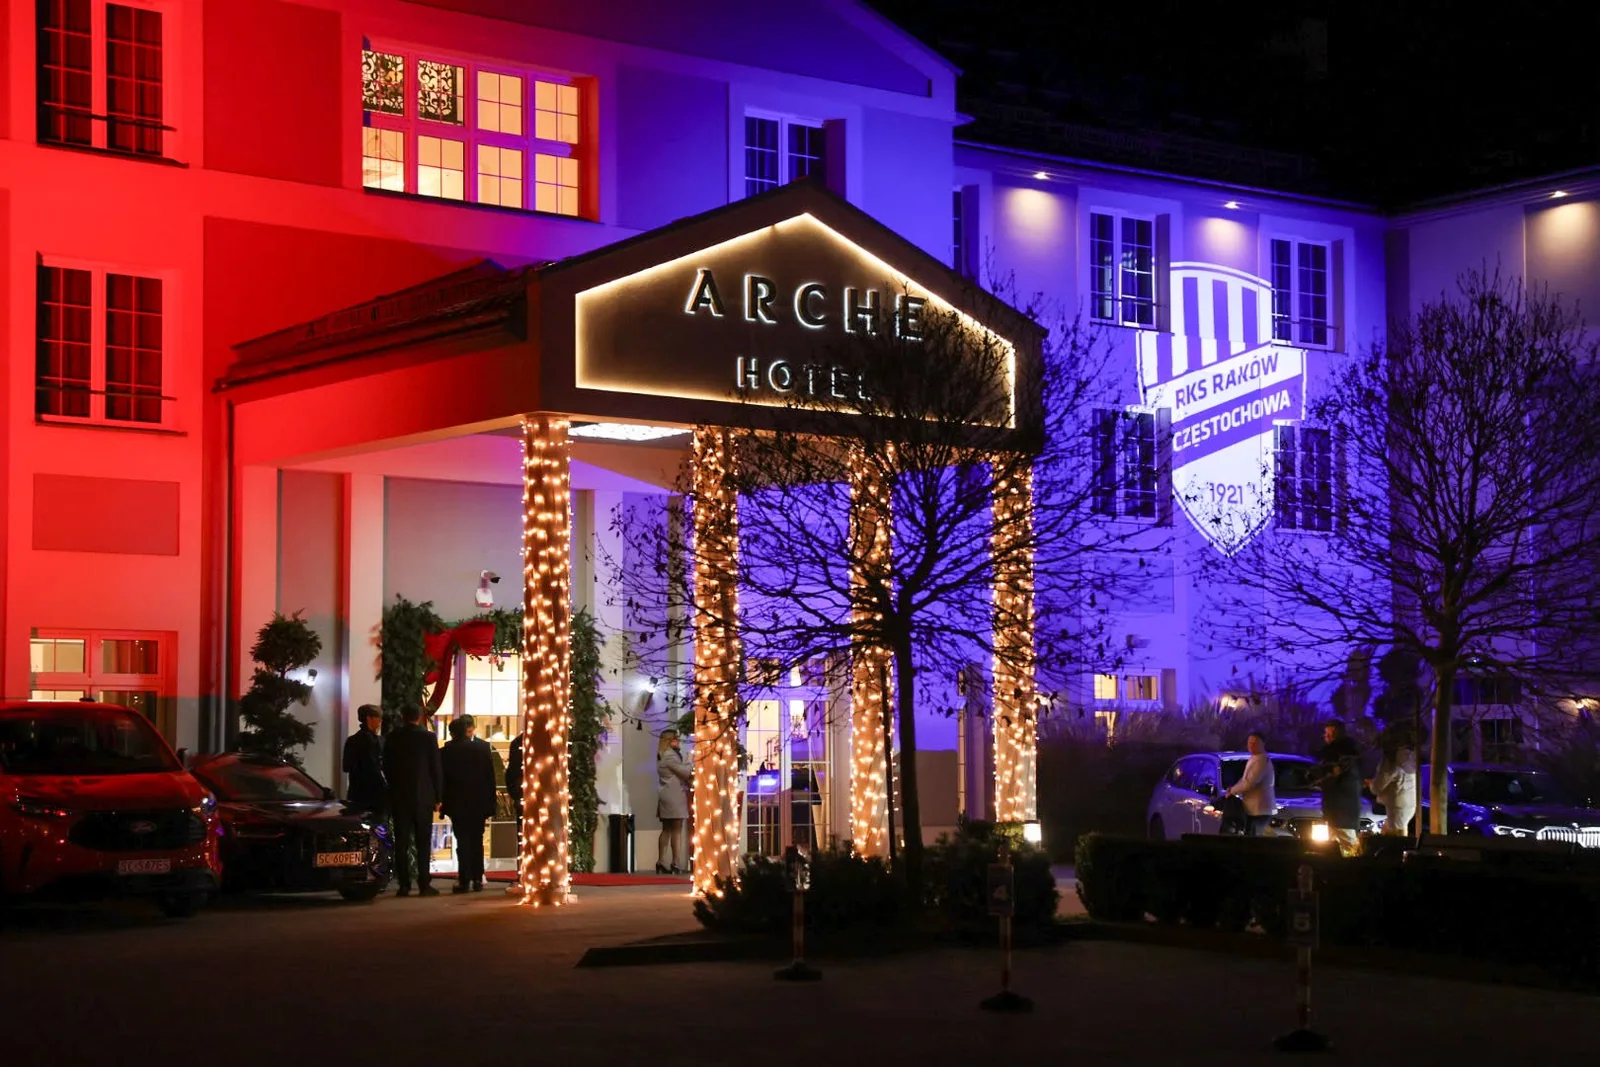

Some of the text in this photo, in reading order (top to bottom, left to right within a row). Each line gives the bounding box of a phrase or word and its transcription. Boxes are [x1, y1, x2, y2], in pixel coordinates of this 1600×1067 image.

[683, 267, 927, 341] ARCHE
[1175, 352, 1279, 410] RKS RAKÓW
[1172, 389, 1291, 452] CZĘSTOCHOWA
[1208, 482, 1244, 505] 1921
[319, 854, 330, 865] SC
